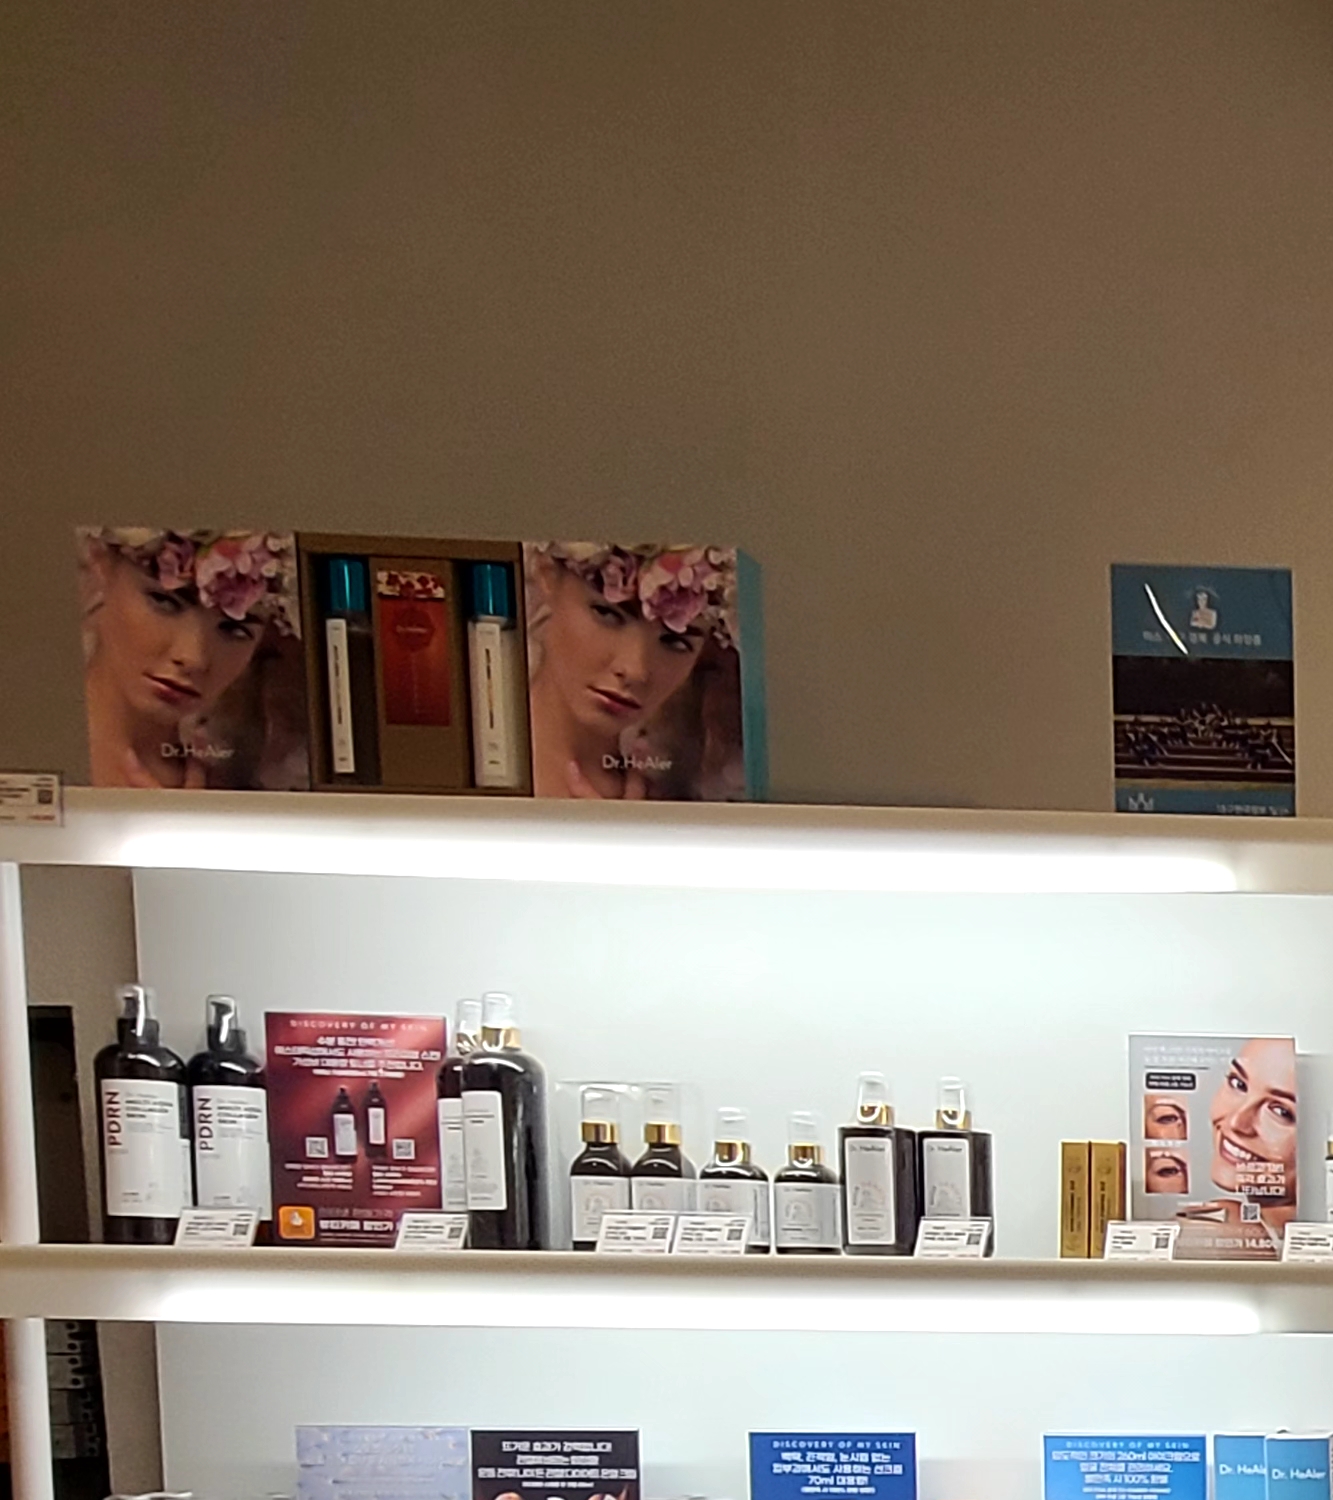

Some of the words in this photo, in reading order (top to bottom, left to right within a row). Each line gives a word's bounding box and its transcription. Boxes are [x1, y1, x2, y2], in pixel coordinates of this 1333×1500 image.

[161, 743, 235, 759] Dr.HeAler
[603, 754, 672, 770] Dr.HeAler
[106, 1091, 122, 1147] PDRN
[197, 1097, 214, 1152] PDRN
[1220, 1463, 1233, 1475] Dr.
[1272, 1469, 1287, 1480] Dr.
[1290, 1469, 1326, 1479] HeAler
